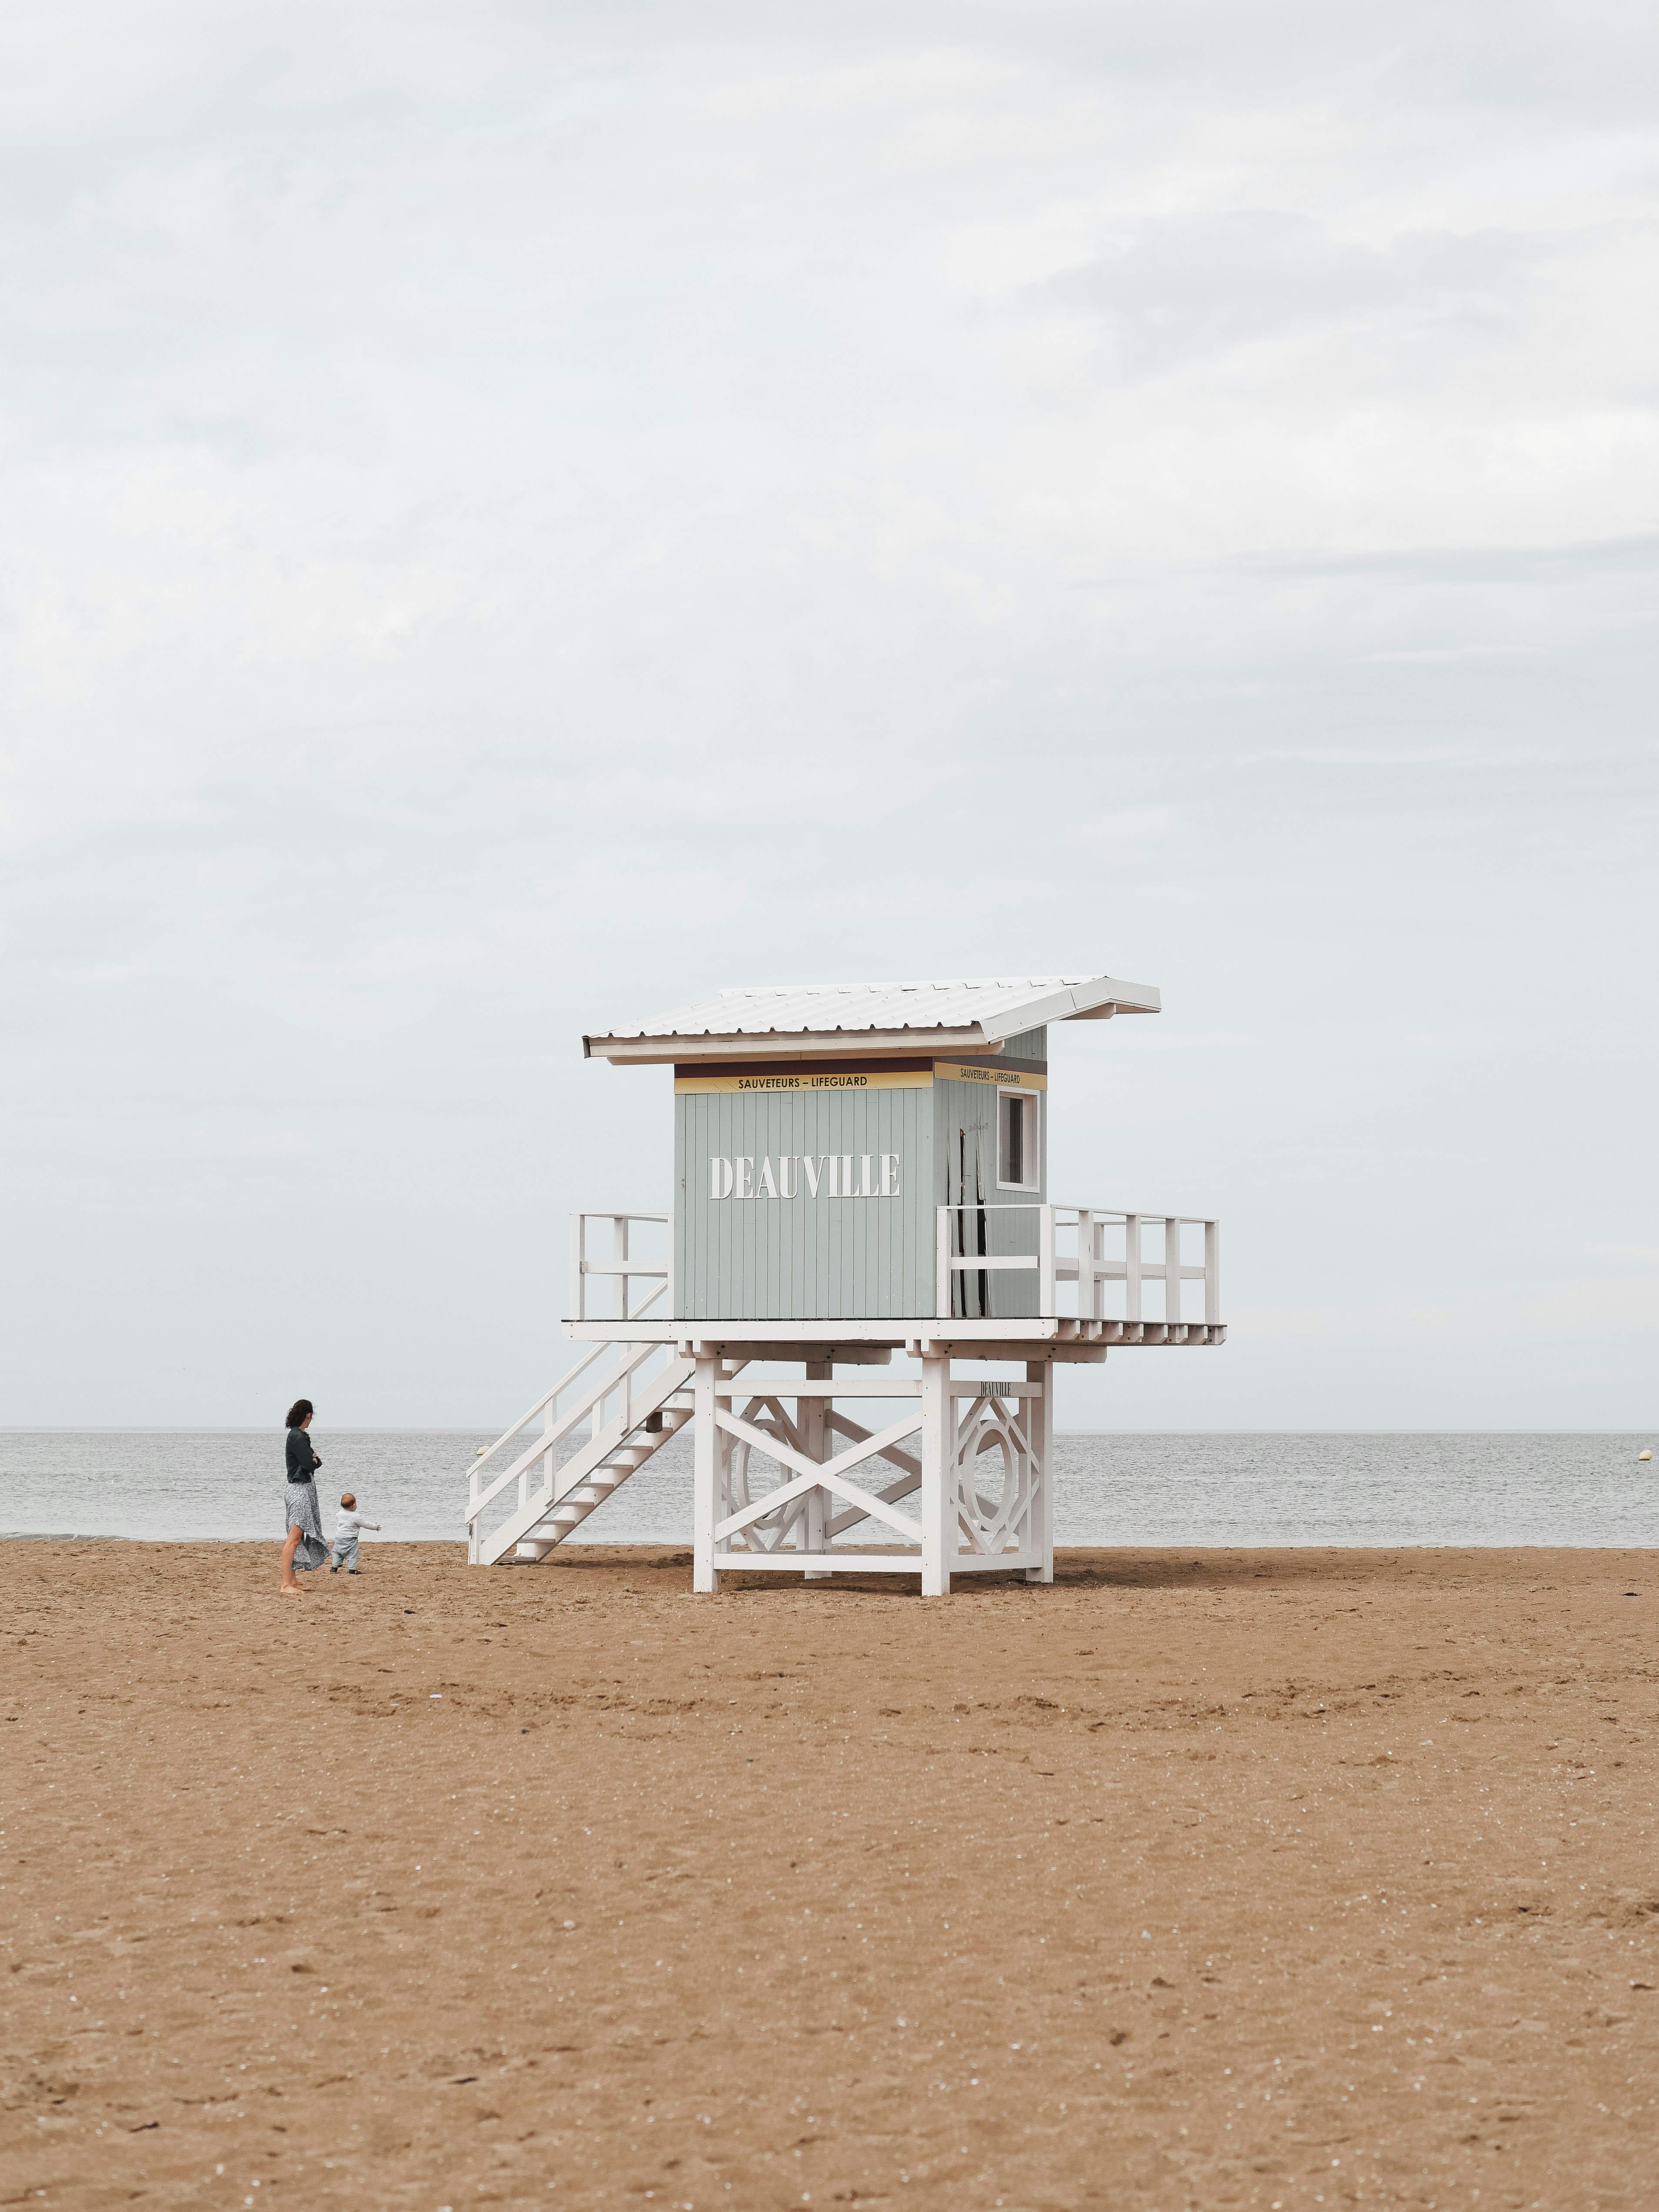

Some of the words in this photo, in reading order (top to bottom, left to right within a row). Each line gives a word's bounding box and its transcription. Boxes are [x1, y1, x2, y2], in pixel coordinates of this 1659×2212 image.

[738, 1078, 800, 1089] SAUVETEURS
[811, 1076, 868, 1087] LIFEGUARD
[960, 1068, 989, 1081] SAUVETEURS
[994, 1072, 1020, 1084] LIFEGUARD
[709, 1154, 900, 1200] DEAUVILLE
[981, 1381, 1011, 1397] DEAUVILLE
